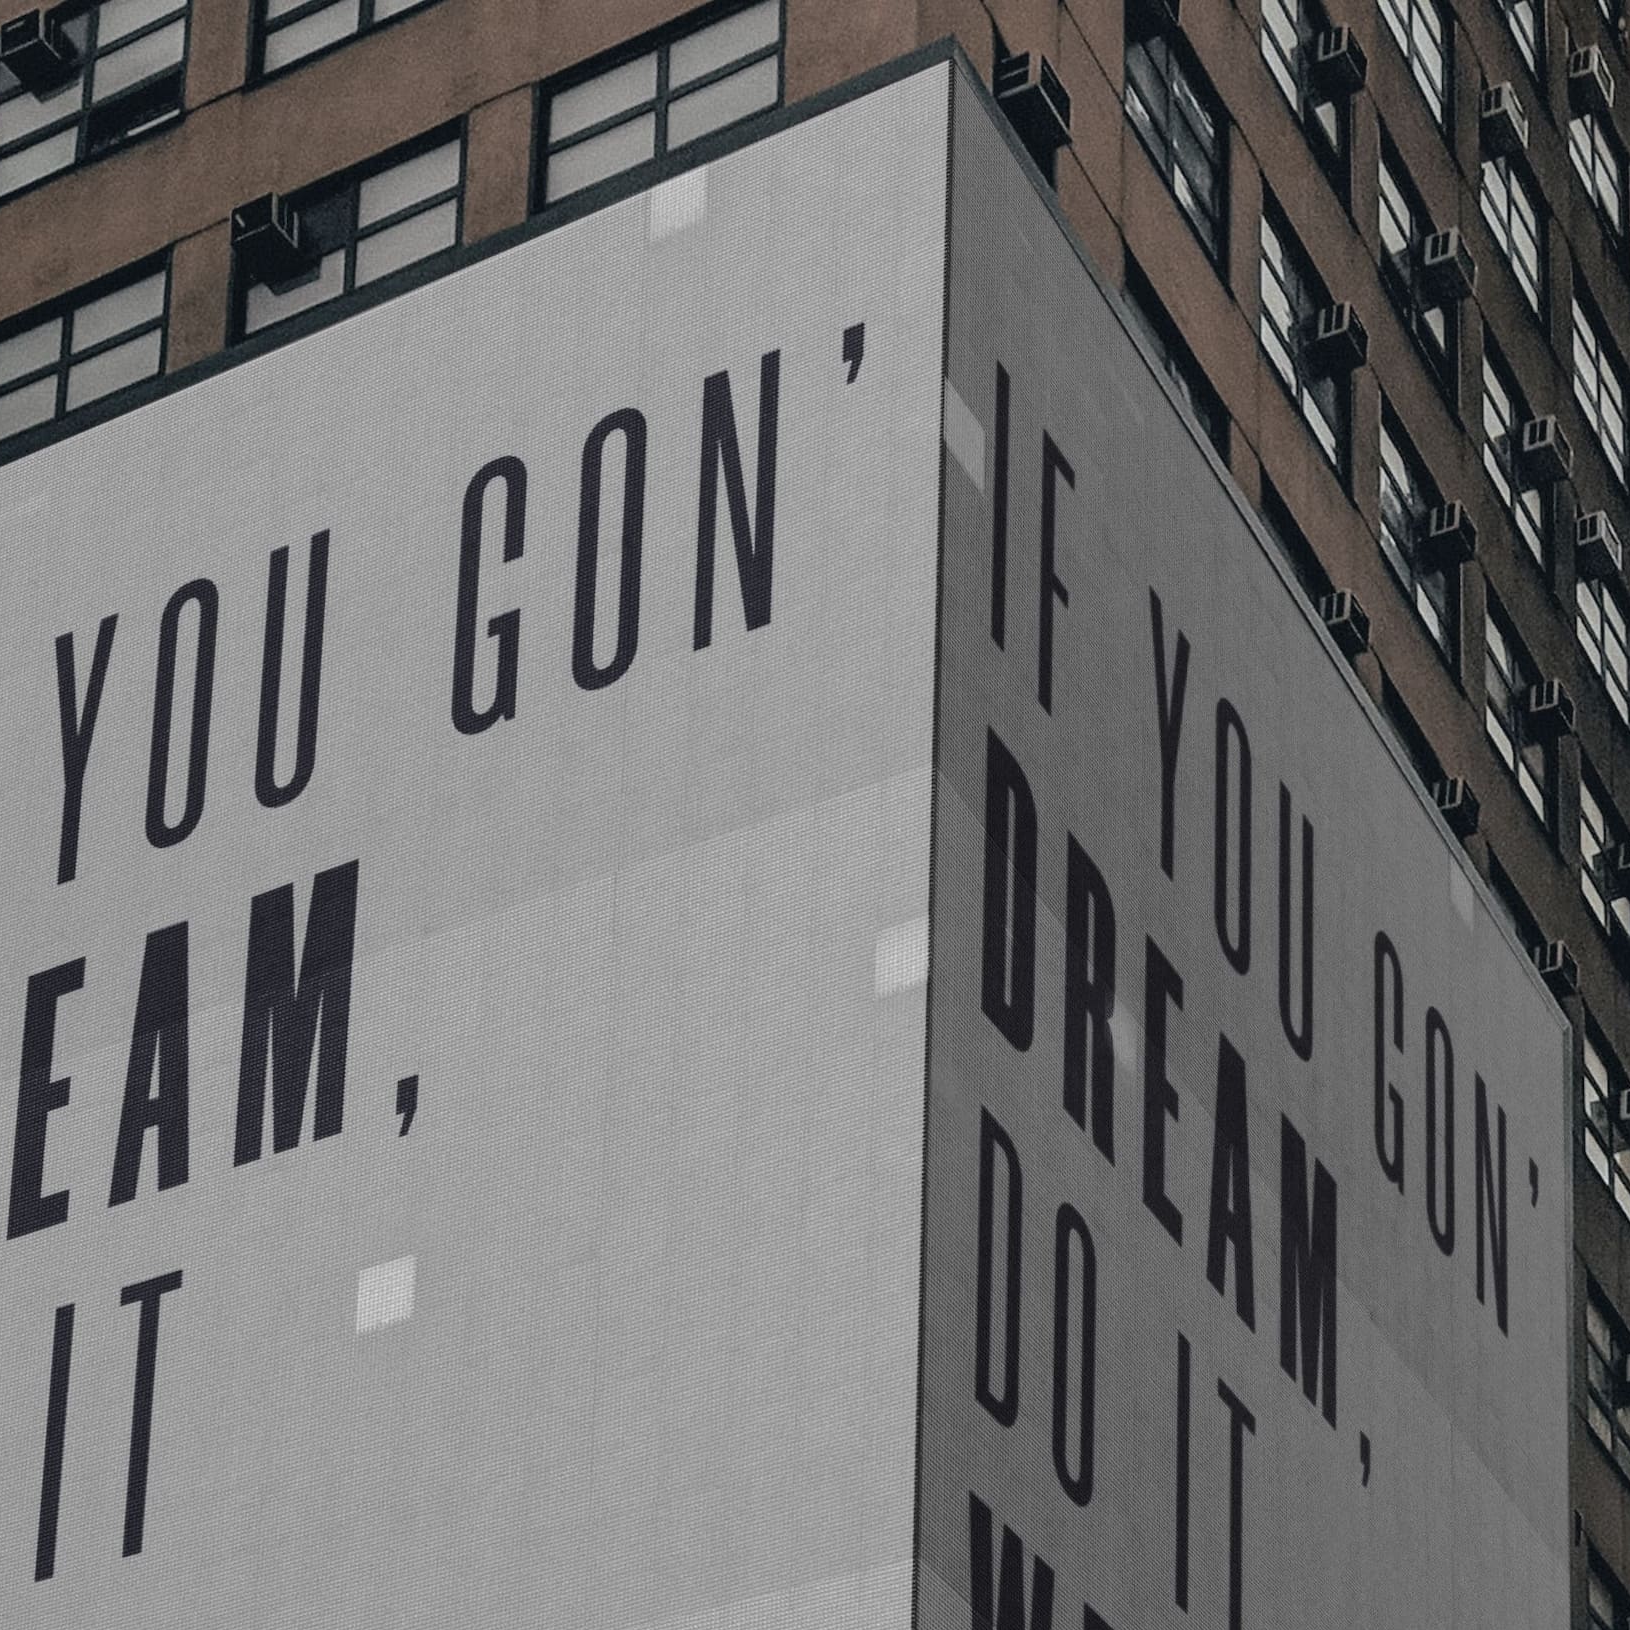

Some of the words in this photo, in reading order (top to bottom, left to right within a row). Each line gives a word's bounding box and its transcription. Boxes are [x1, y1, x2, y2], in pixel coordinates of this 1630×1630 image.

[54, 528, 331, 886] YOU
[450, 322, 866, 736] GON'
[989, 360, 1076, 716] IF
[1148, 586, 1315, 1063] YOU
[973, 1105, 1098, 1509] DO
[981, 724, 1371, 1488] DREAM,
[33, 1269, 184, 1583] IT
